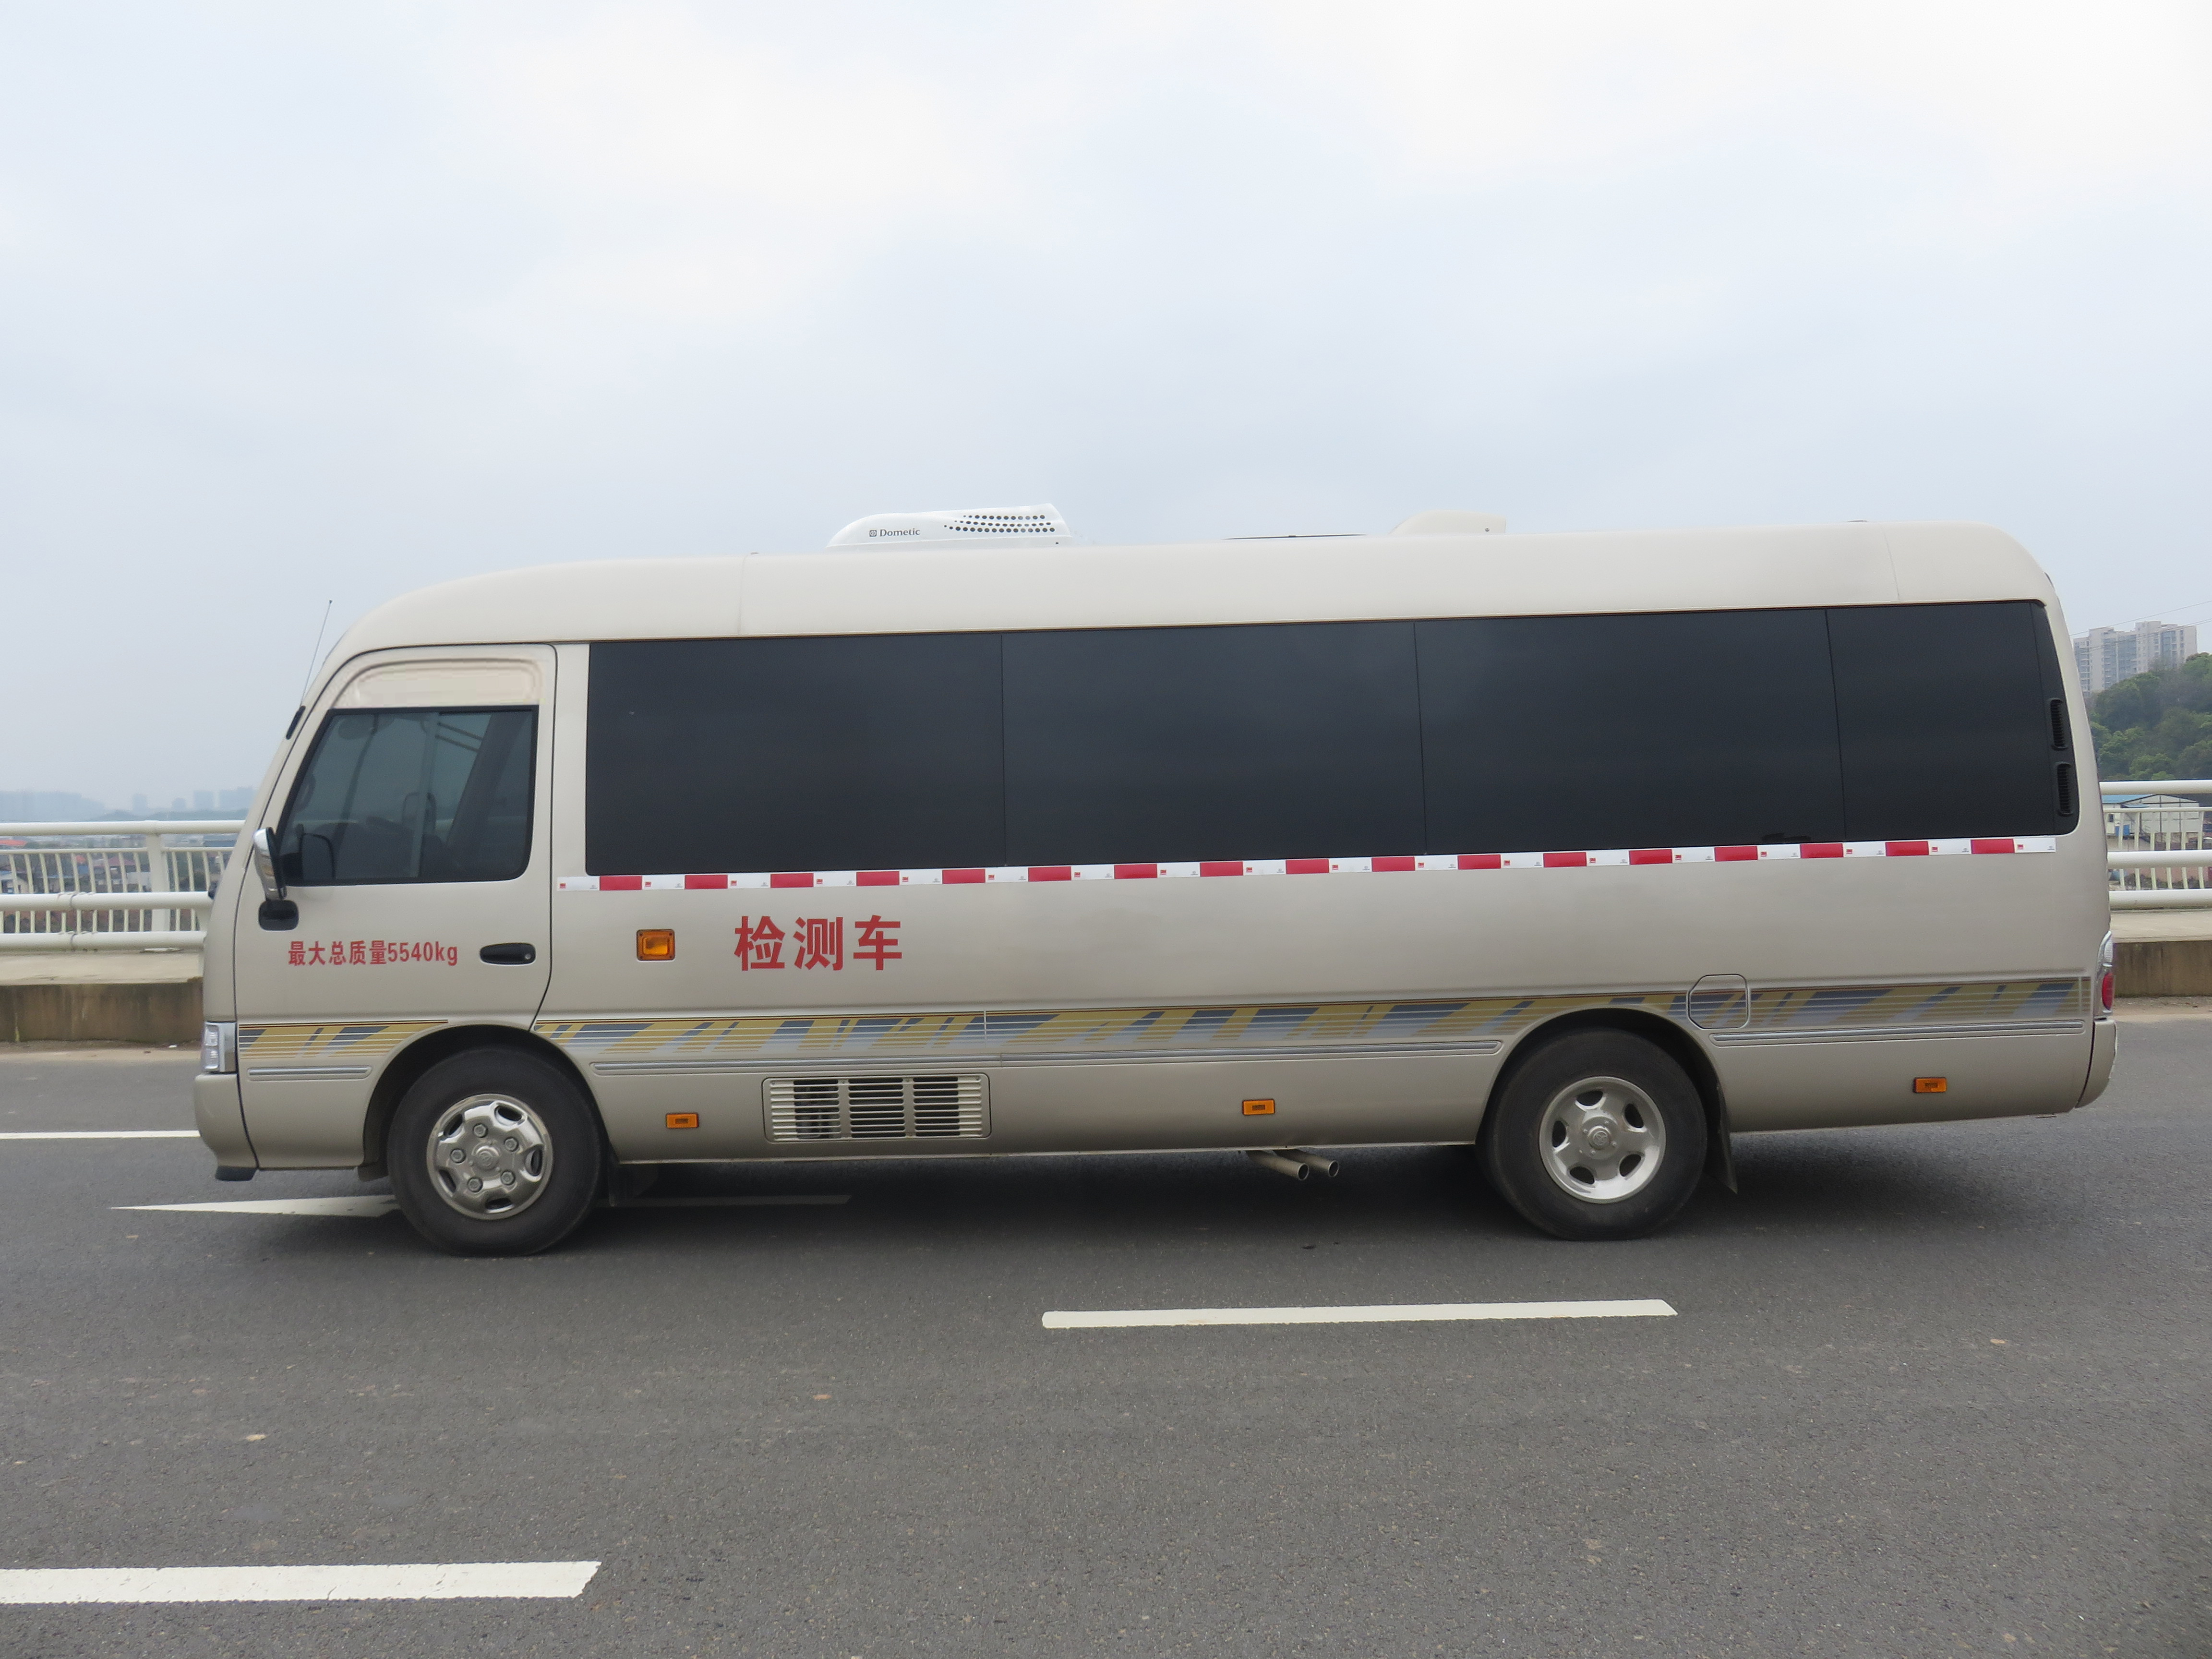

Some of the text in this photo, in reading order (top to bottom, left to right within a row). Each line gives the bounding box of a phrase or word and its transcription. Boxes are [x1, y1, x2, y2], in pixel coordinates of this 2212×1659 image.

[879, 528, 920, 537] Dometic
[288, 939, 458, 966] 最大总质量5540kg
[734, 914, 903, 972] 检测车
